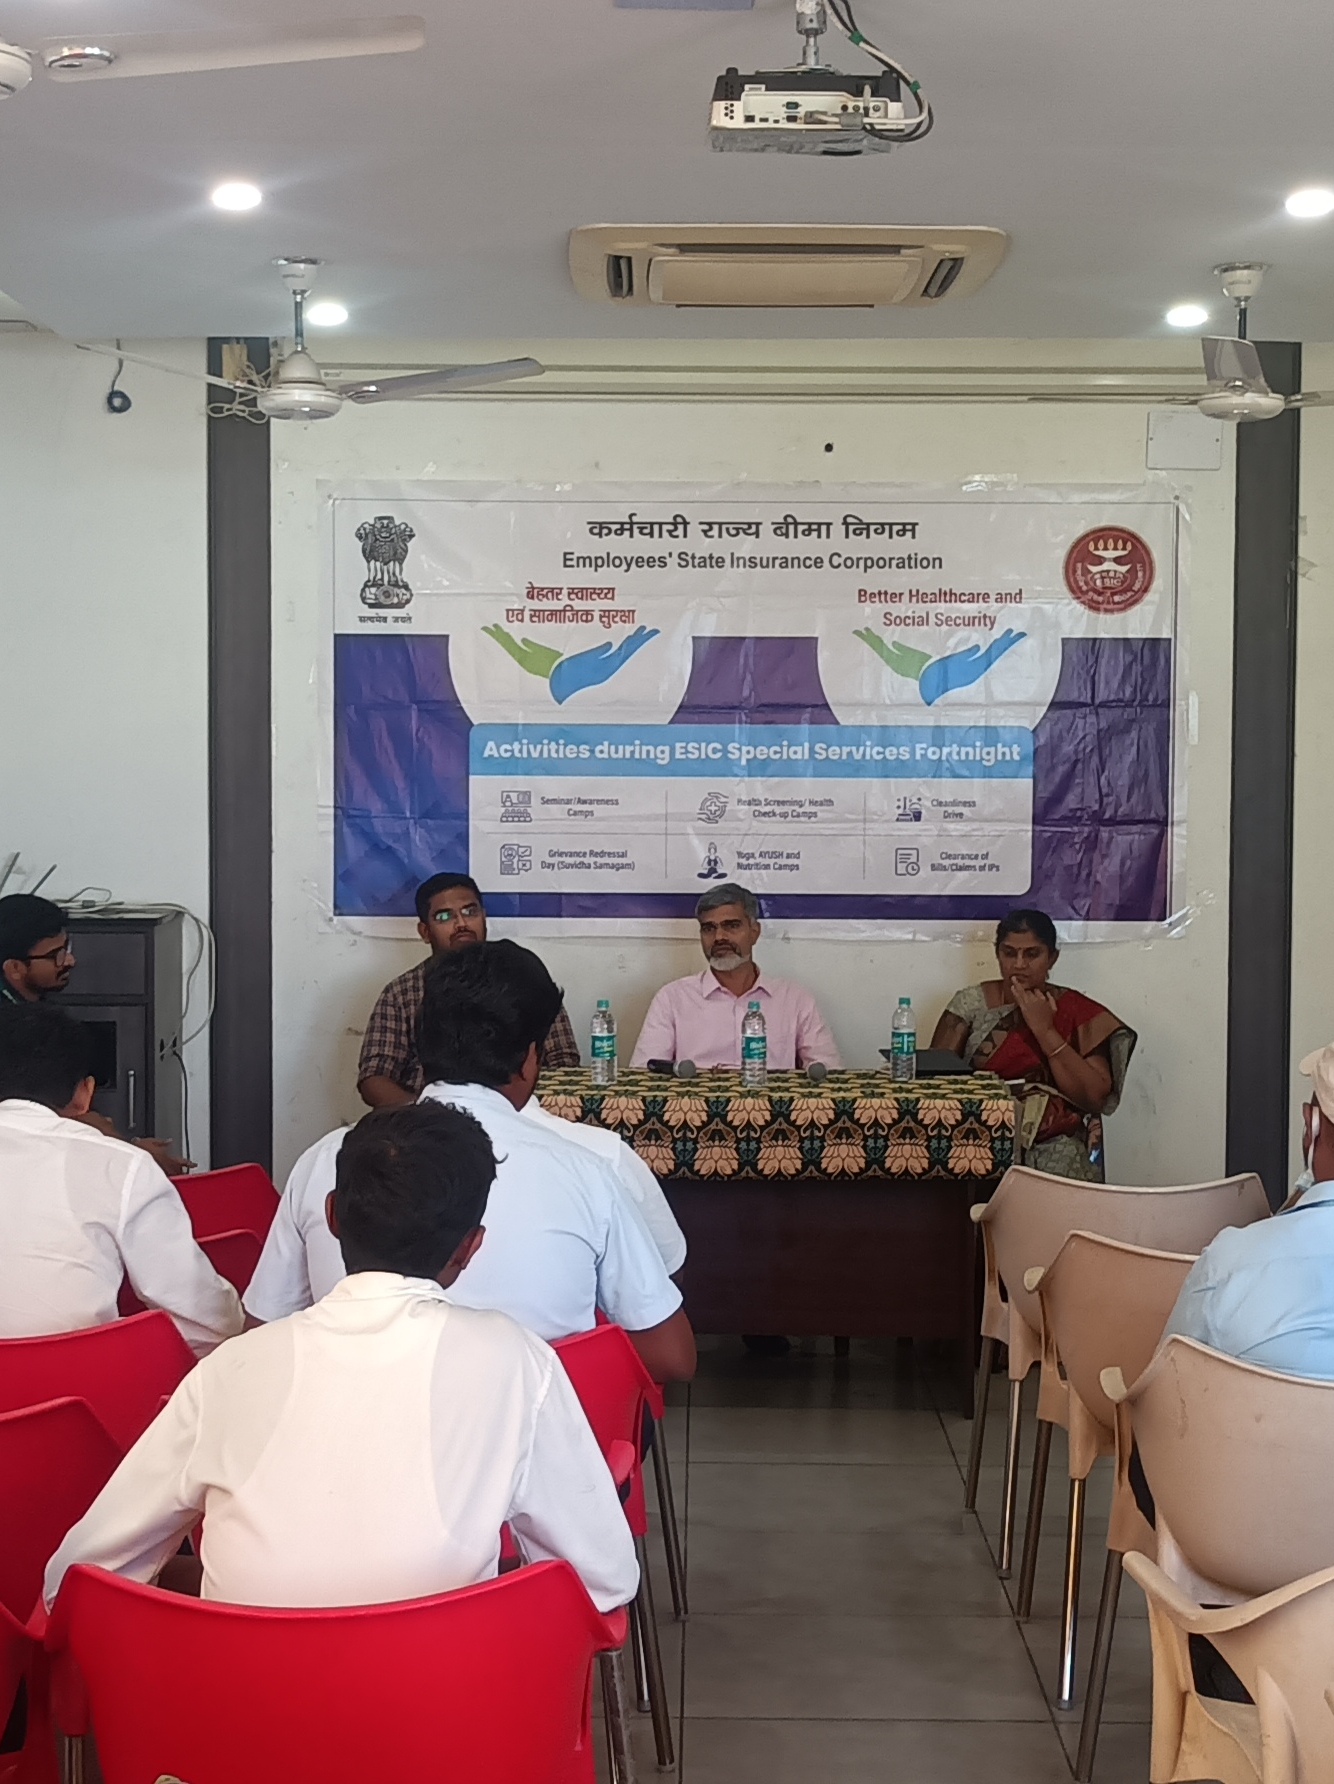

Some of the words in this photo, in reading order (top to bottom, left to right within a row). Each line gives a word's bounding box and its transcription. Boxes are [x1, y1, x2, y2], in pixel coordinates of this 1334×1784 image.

[587, 513, 689, 540] कर्मचारी
[700, 520, 762, 540] राज्य
[772, 514, 832, 540] बीमा
[841, 514, 919, 540] निगम
[562, 551, 673, 573] Employees'
[677, 552, 726, 569] State
[730, 552, 824, 570] Insurance
[828, 553, 943, 574] Corporation
[525, 581, 564, 602] बेहतर
[566, 587, 615, 601] स्वास्थ्य
[857, 589, 905, 604] Better
[908, 589, 990, 604] Healthcare
[994, 589, 1023, 604] and
[505, 606, 526, 623] एवं
[529, 604, 595, 624] सामाजिक
[598, 609, 636, 629] सुरक्षा
[883, 611, 929, 627] Social
[934, 611, 997, 631] Security
[483, 740, 591, 760] Activities
[594, 740, 671, 765] during
[675, 742, 723, 760] ESIC
[727, 741, 809, 766] Special
[814, 741, 910, 761] Services
[915, 741, 1021, 766] Fortnight
[541, 796, 619, 806] Seminar/Awareness
[737, 797, 763, 807] Health
[764, 797, 807, 809] Screening/
[808, 798, 834, 807] Health
[931, 799, 976, 808] Cleanliness
[567, 808, 594, 819] Camps
[752, 808, 789, 820] Check-up
[790, 809, 818, 820] Camps
[943, 810, 964, 819] Drive
[548, 849, 587, 858] Grievance
[588, 849, 627, 858] Redressal
[736, 851, 757, 861] Yoga,
[758, 851, 784, 859] AYUSH
[785, 851, 801, 859] and
[940, 851, 979, 860] Clearance
[980, 851, 989, 860] of
[540, 861, 555, 871] Day
[557, 861, 591, 871] (Suvidha
[593, 861, 635, 871] Samagam)
[736, 862, 771, 871] Nutrition
[772, 862, 800, 872] Camps
[930, 863, 977, 872] Bills/Claims
[978, 863, 987, 872] of
[987, 863, 1000, 872] IPs
